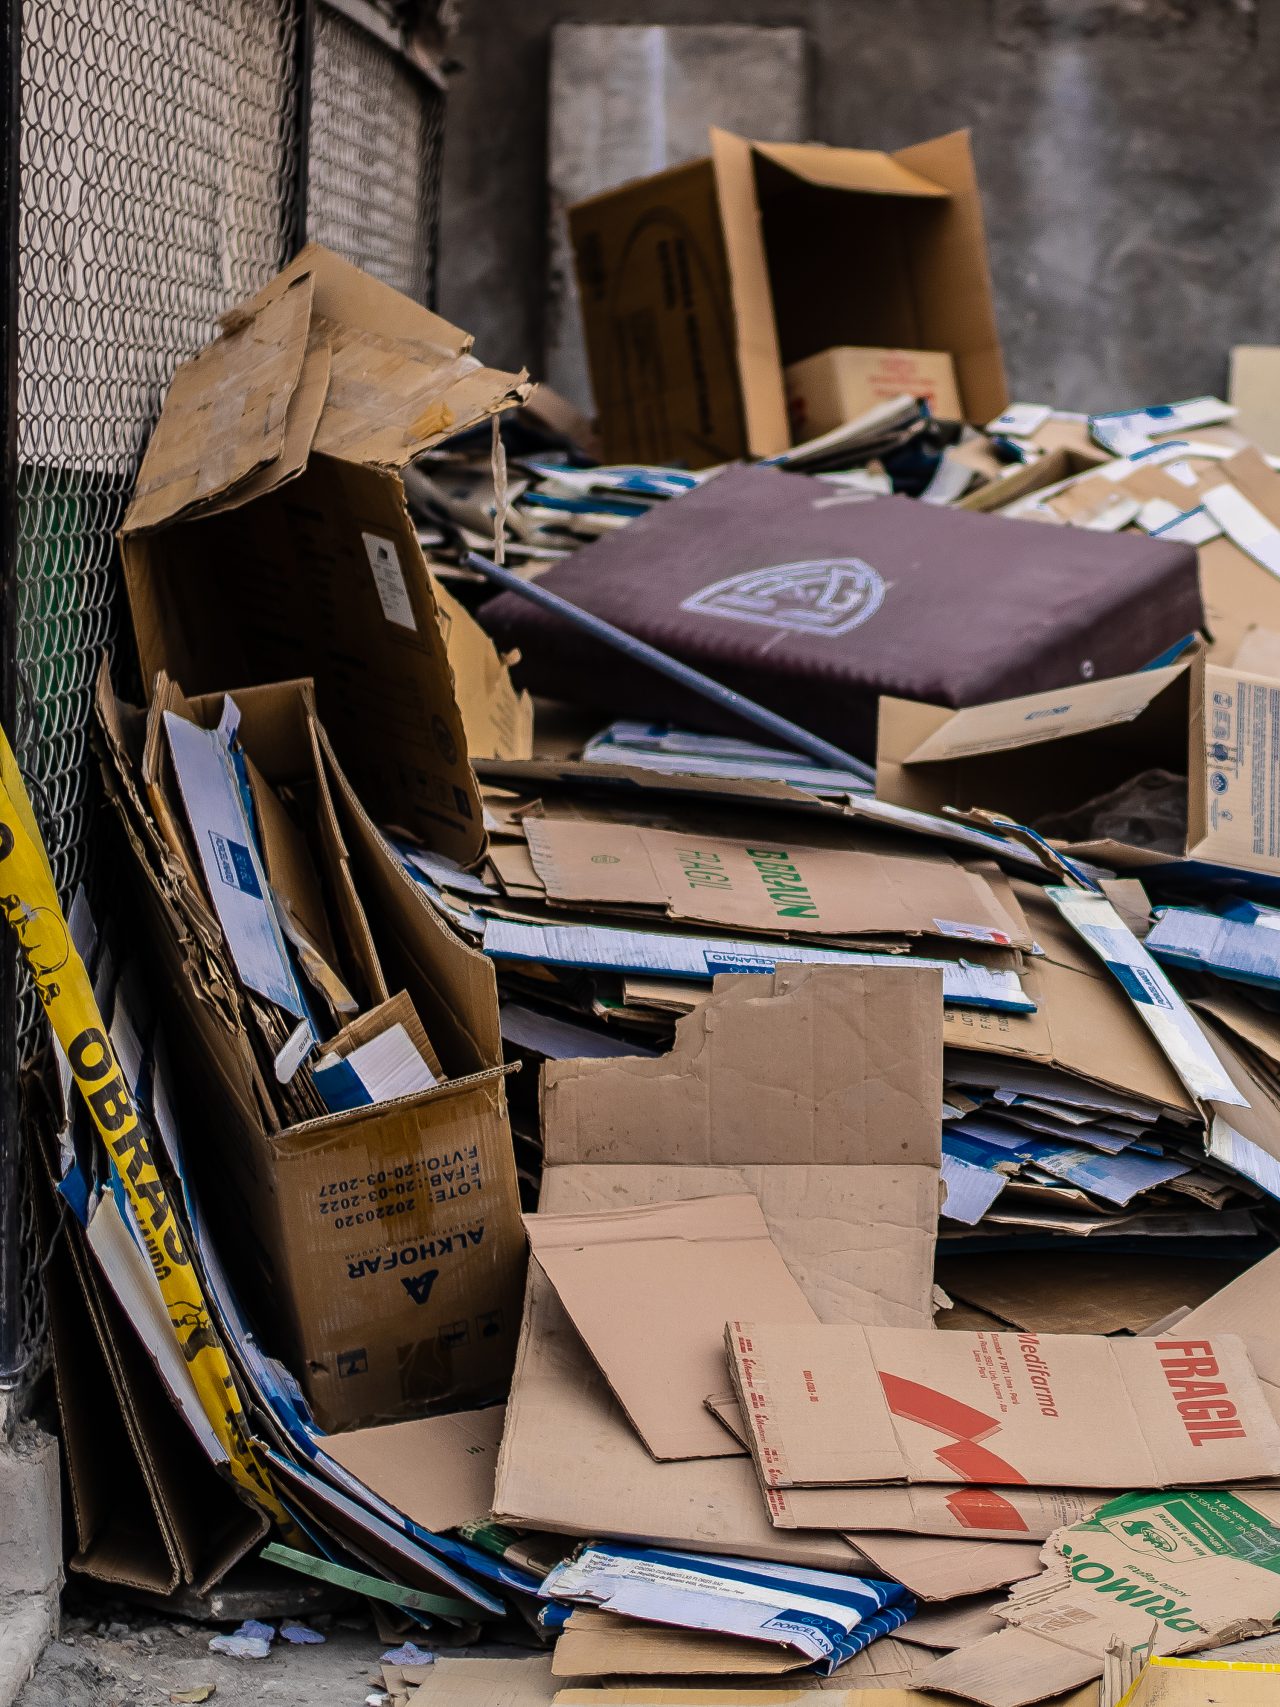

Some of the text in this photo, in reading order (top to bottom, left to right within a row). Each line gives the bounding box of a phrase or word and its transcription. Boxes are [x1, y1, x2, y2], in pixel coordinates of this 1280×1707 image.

[334, 1198, 416, 1229] 20220320
[348, 1226, 485, 1279] ALKHOFAR
[1017, 1332, 1059, 1418] Medifarma
[1154, 1340, 1247, 1447] FRAGIL
[1123, 1564, 1159, 1585] Vegetal
[801, 1616, 823, 1625] 60
